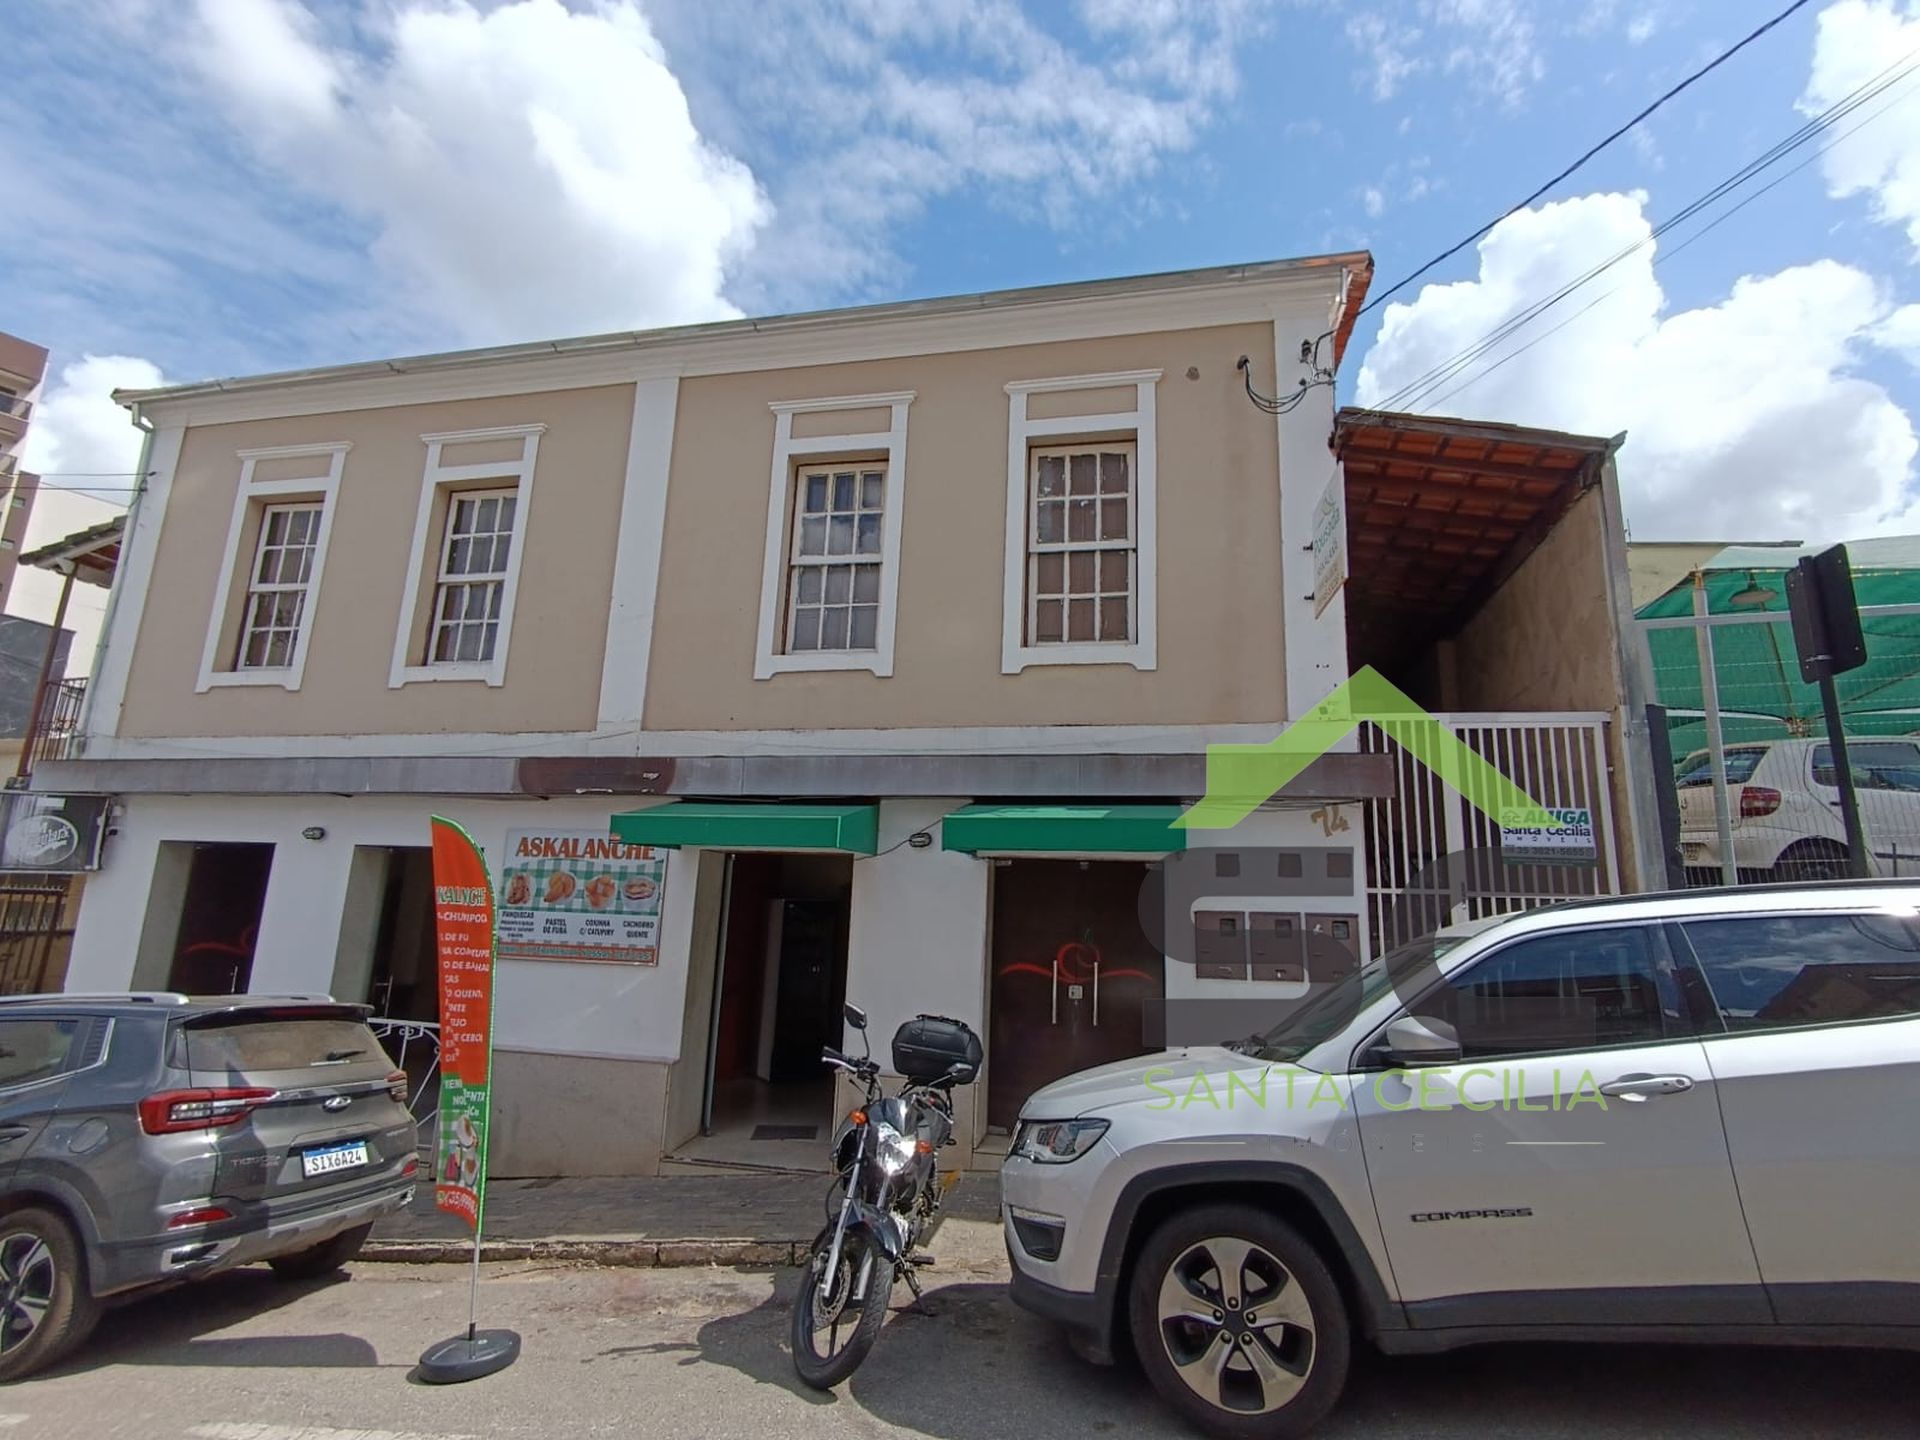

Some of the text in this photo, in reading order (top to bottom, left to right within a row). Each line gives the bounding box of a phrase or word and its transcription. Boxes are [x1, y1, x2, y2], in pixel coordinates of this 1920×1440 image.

[1523, 810, 1590, 825] ALUGA
[1503, 823, 1541, 835] Santa
[515, 835, 656, 861] ASKALANCHE
[545, 918, 567, 926] PASTEL
[543, 926, 551, 934] DE
[626, 930, 649, 938] QUENTE
[311, 1150, 363, 1173] SIX6A24
[1410, 1207, 1533, 1222] COMPASS
